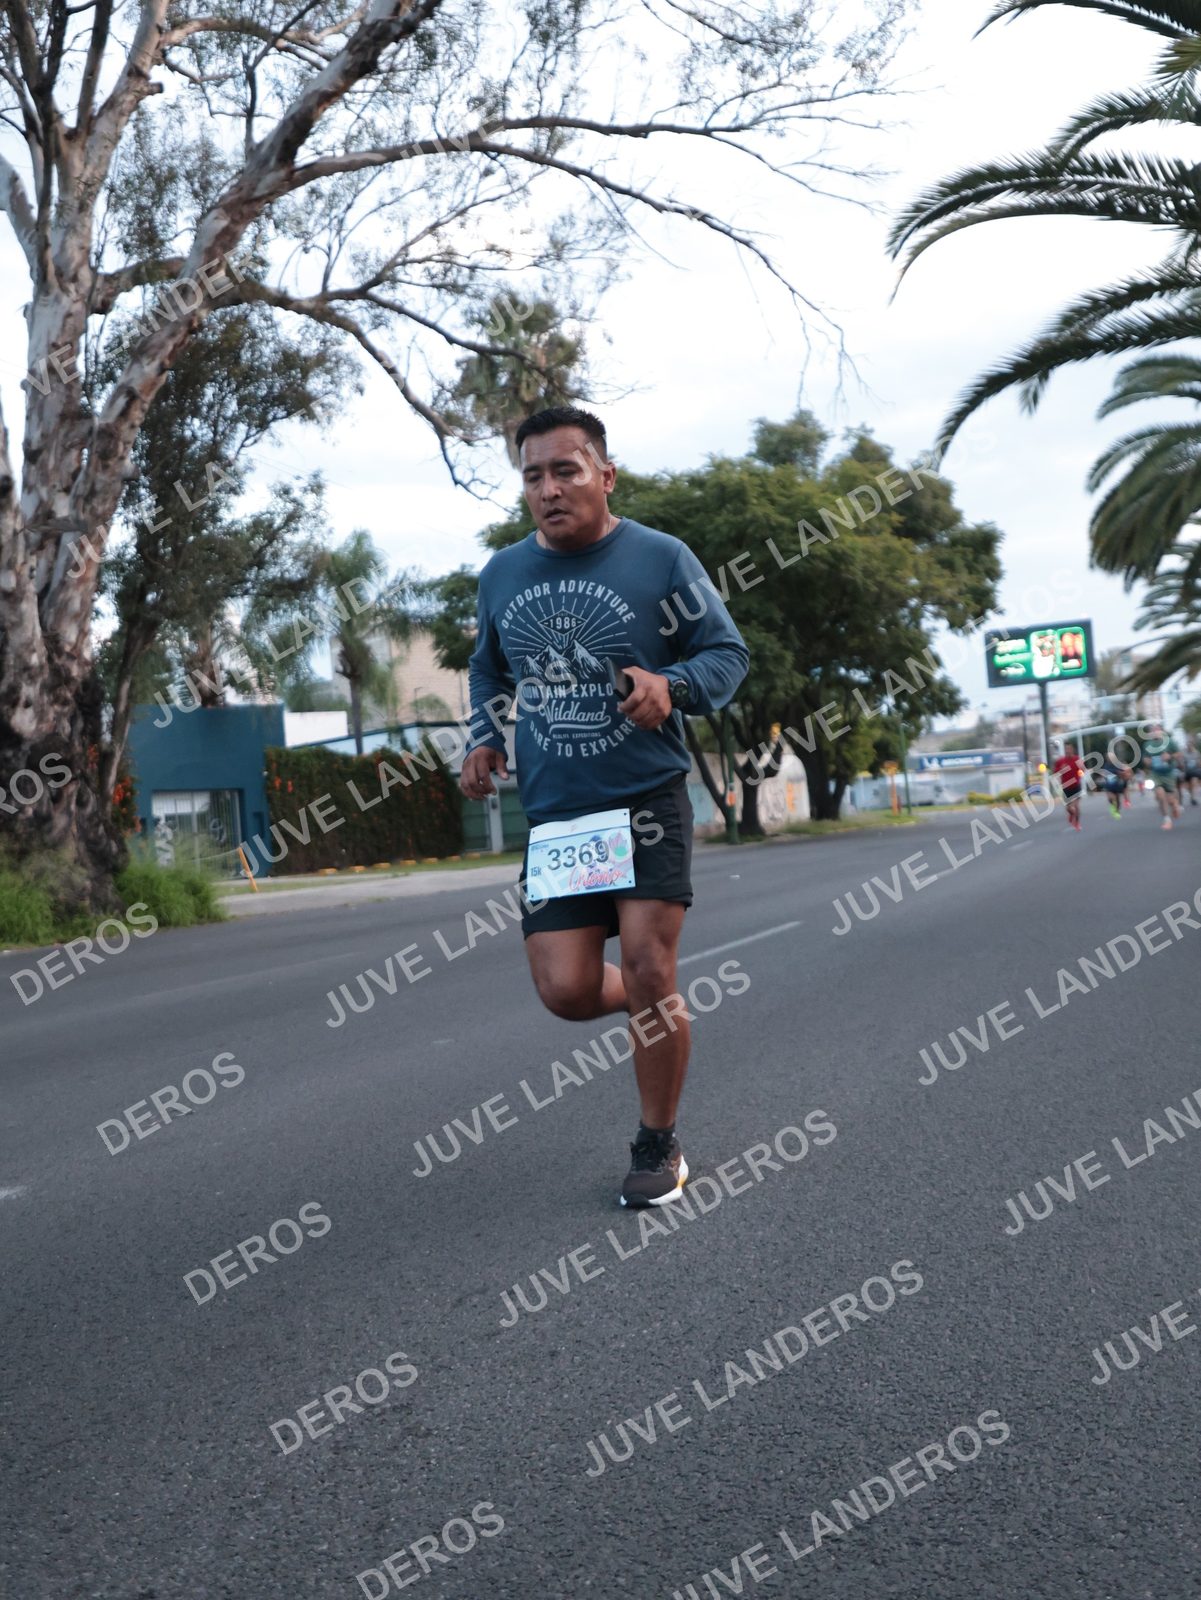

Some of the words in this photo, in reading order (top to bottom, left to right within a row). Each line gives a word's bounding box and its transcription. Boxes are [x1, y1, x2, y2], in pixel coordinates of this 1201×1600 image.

[502, 582, 551, 629] OUTDOOR
[558, 580, 636, 624] ADVENTURE
[571, 682, 614, 698] EXPLO
[539, 699, 611, 724] Wildland
[556, 742, 574, 758] TO
[580, 716, 636, 757] EXPLORE
[547, 840, 610, 871] 3369
